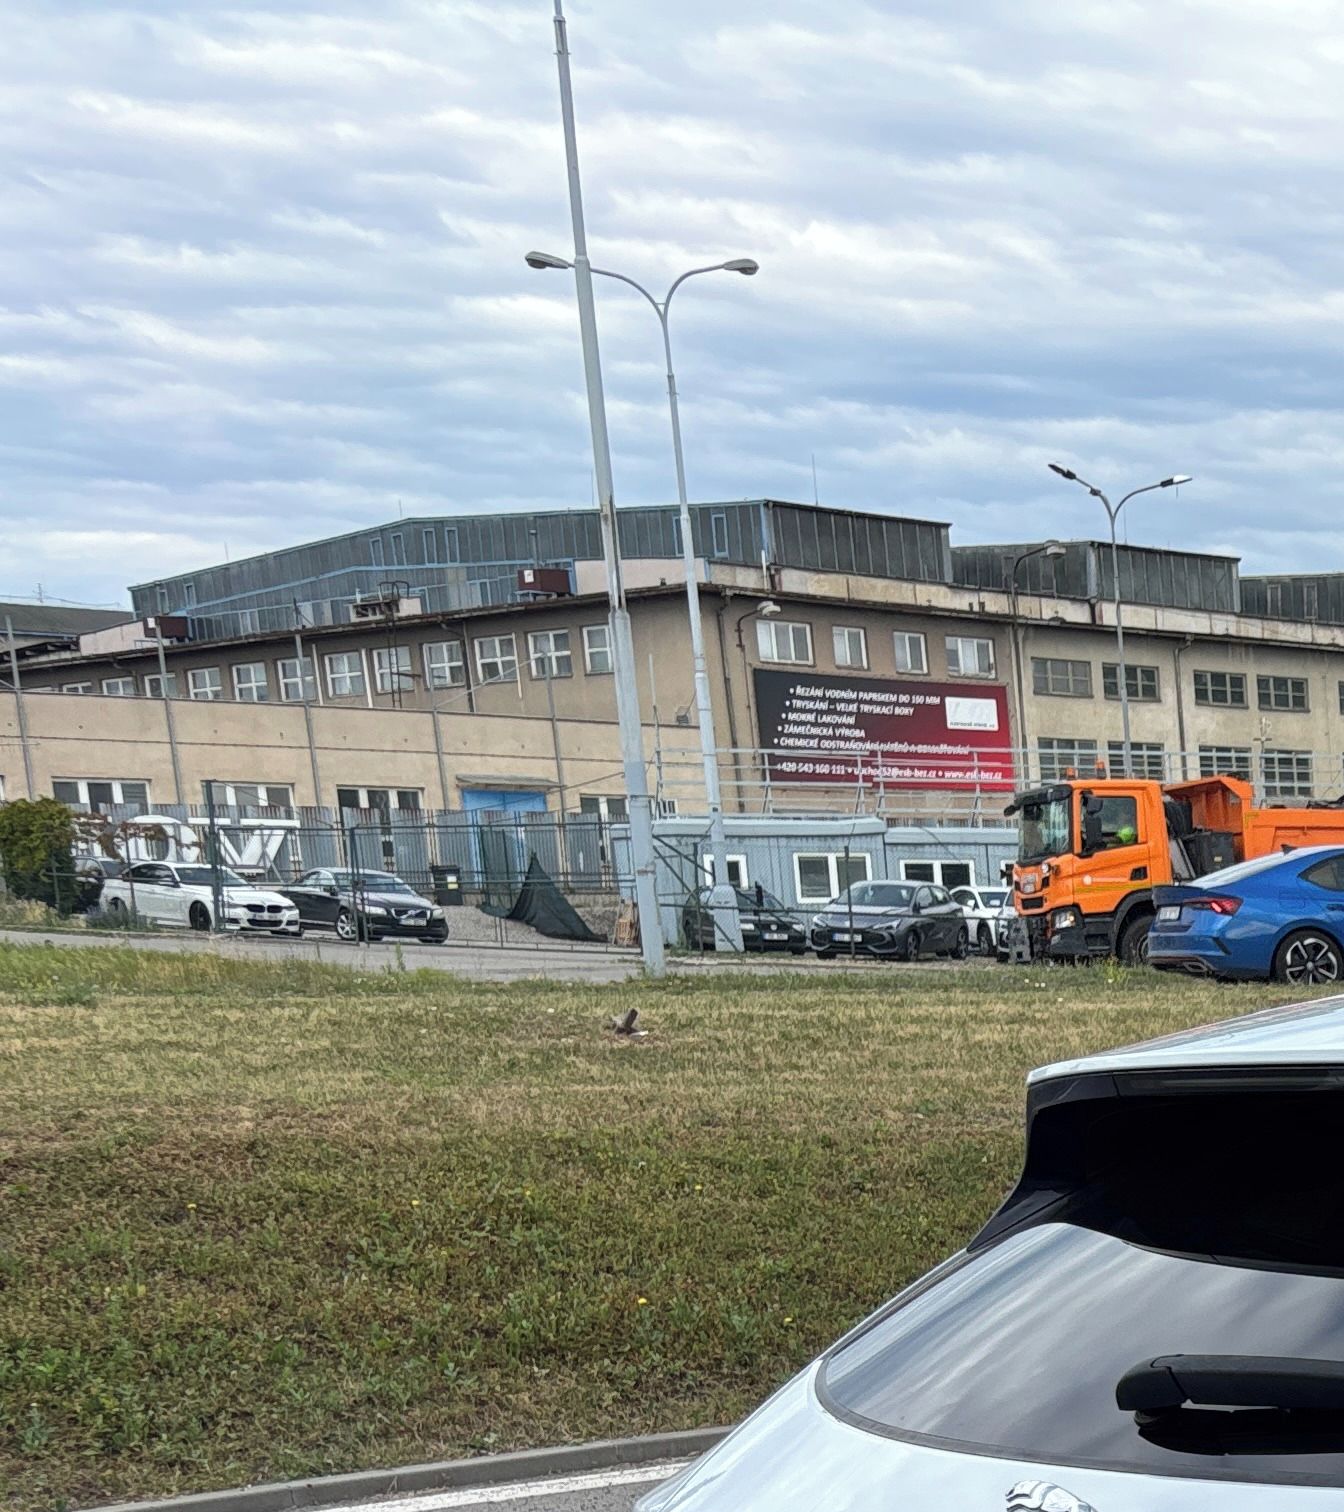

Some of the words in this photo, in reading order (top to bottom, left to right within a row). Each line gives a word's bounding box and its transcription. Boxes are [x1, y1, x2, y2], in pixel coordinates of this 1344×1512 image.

[796, 685, 824, 698] ŘEZÁNÍ
[825, 689, 857, 700] VODNÍM
[859, 690, 897, 702] PAPRSKEM
[899, 695, 910, 703] DO
[925, 696, 940, 705] MM
[792, 699, 828, 711] TRYSKÁNÍ
[836, 702, 858, 712] VELKÉ
[860, 703, 893, 715] TRYSKACÍ
[894, 706, 914, 717] BOXY
[788, 711, 816, 722] MOKRÉ
[818, 713, 855, 725] LAKOVÁNÍ
[784, 723, 833, 736] ZÁMEČNICKÁ
[835, 727, 866, 738] VÝROBA
[780, 736, 819, 748] CHEMICKÉ
